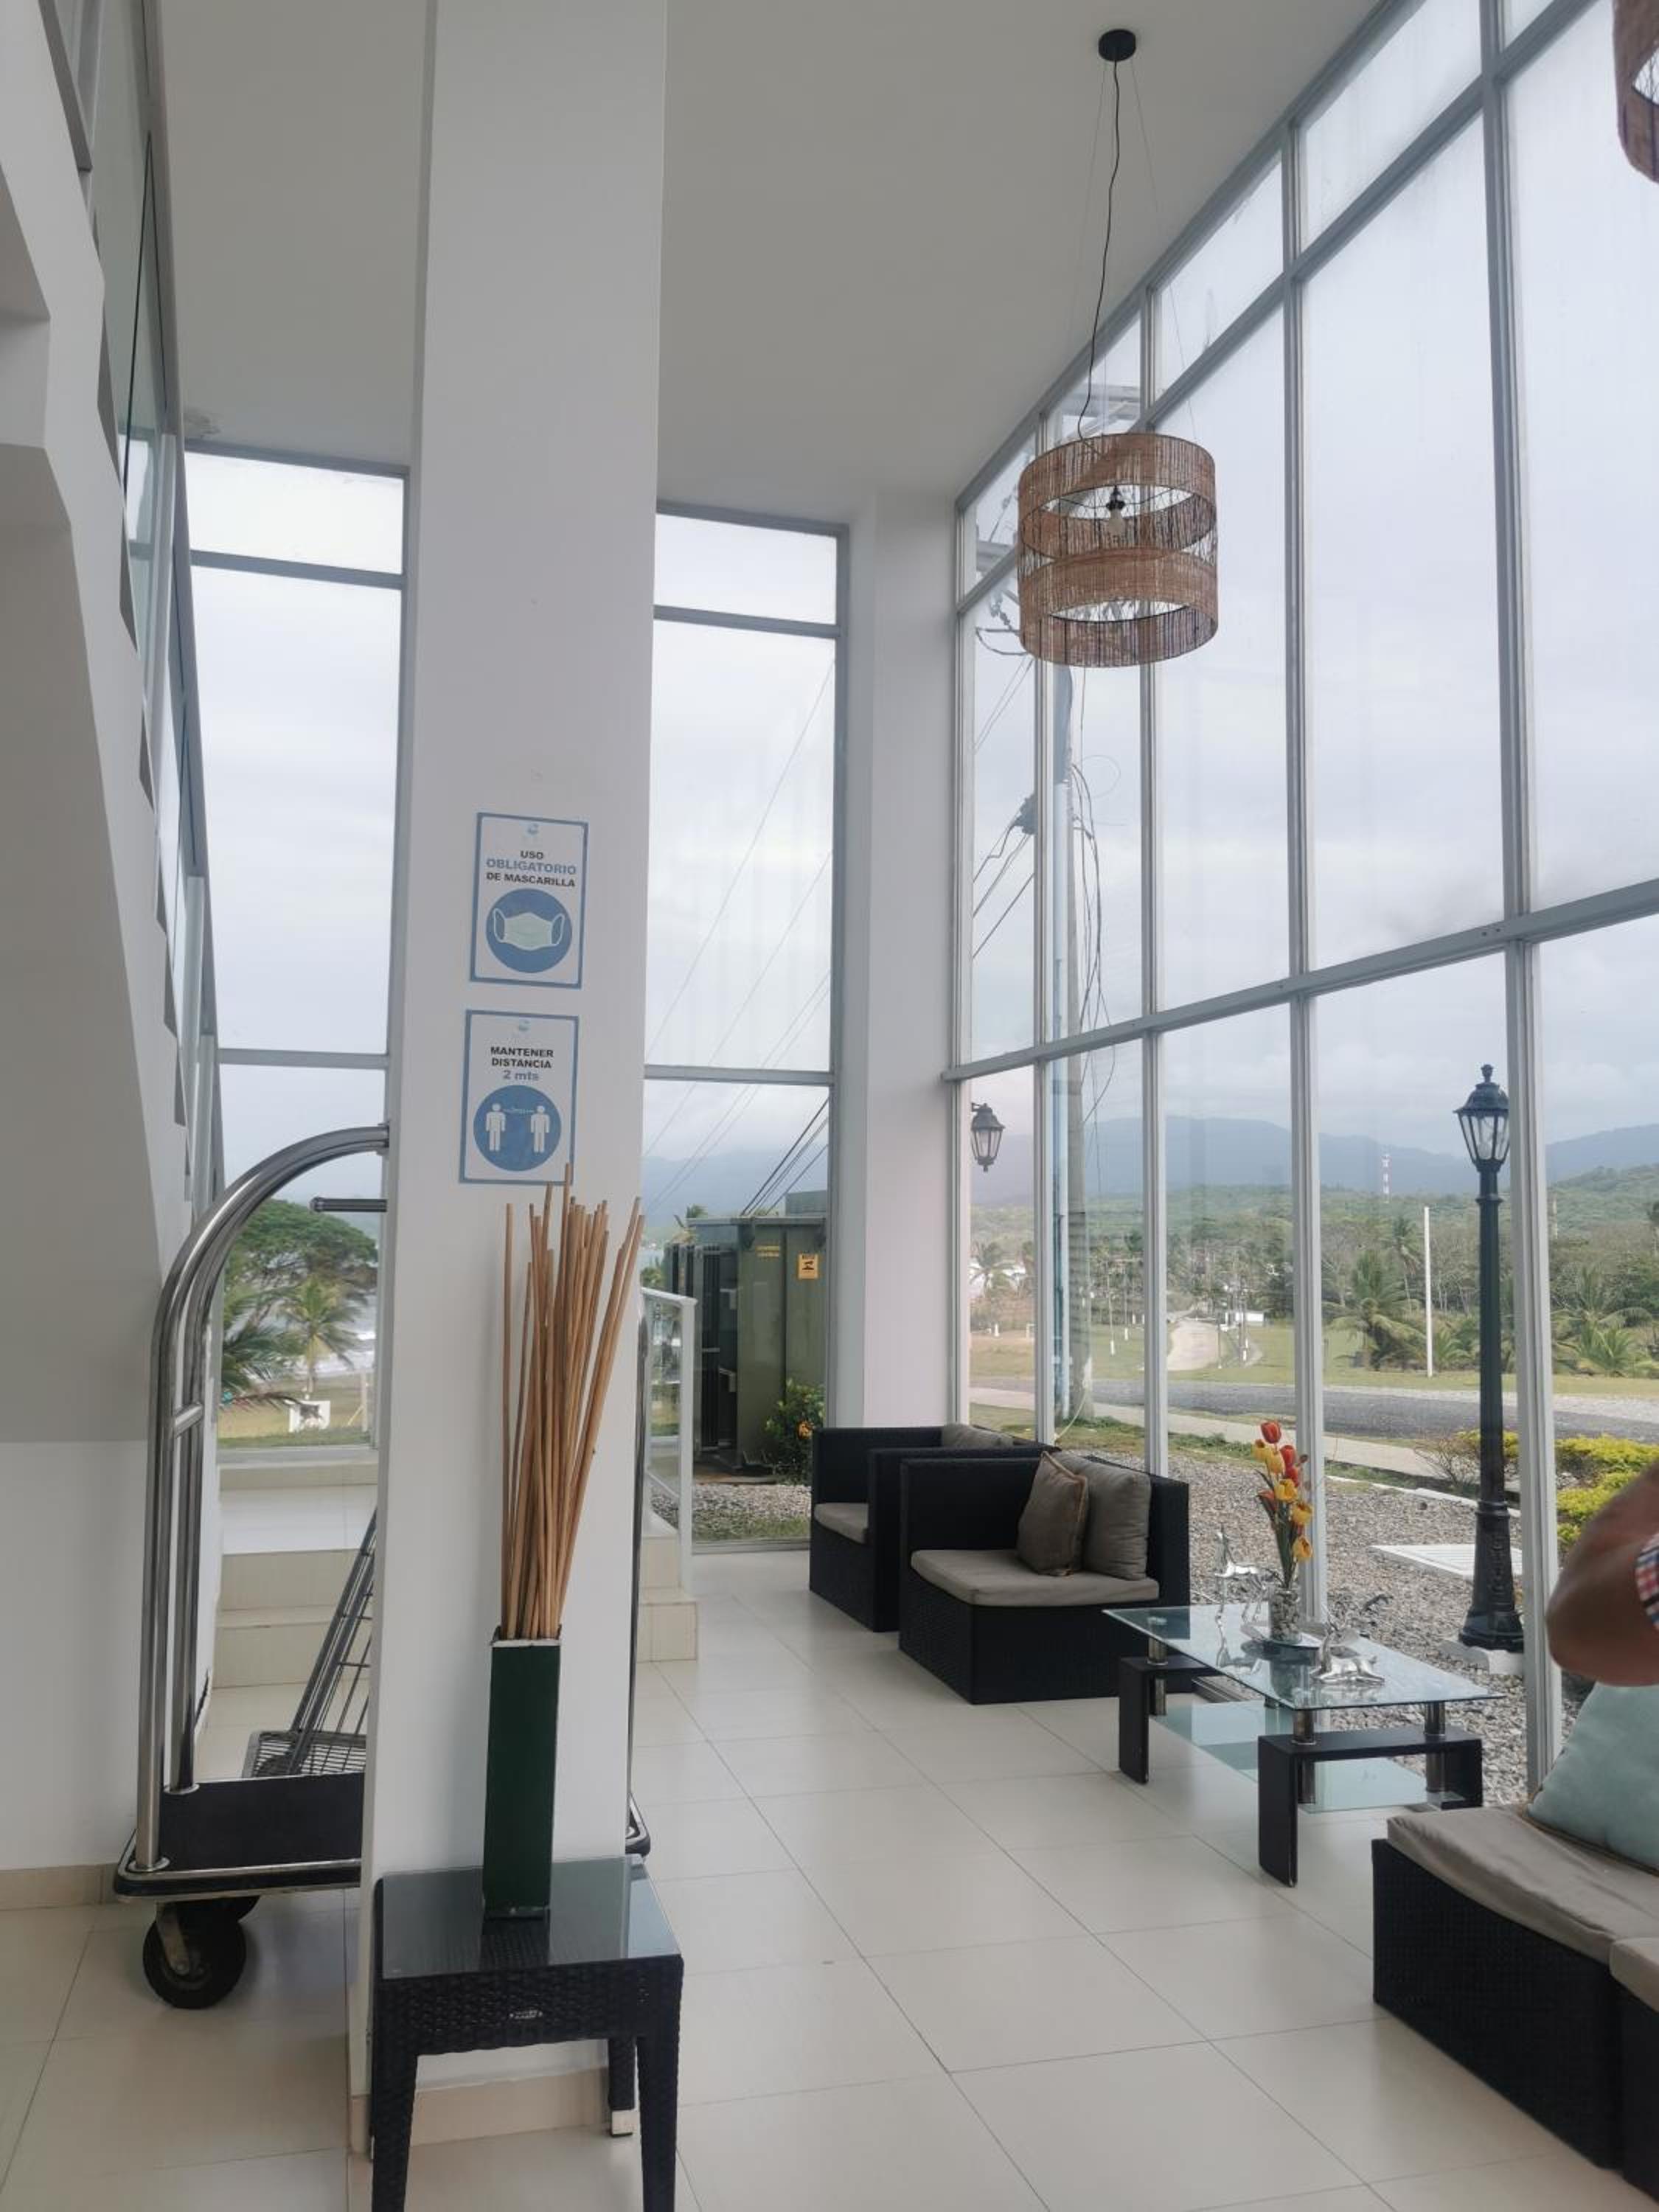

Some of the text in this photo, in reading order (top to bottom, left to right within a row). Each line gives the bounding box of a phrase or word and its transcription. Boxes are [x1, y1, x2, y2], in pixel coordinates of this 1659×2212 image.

[520, 850, 544, 859] USO
[487, 859, 576, 874] OBLIGATORIO
[486, 872, 576, 887] DE MASCARILLA
[490, 1046, 554, 1057] MANTENER
[492, 1057, 552, 1068] DISTANCIA
[503, 1070, 540, 1081] 2 mts
